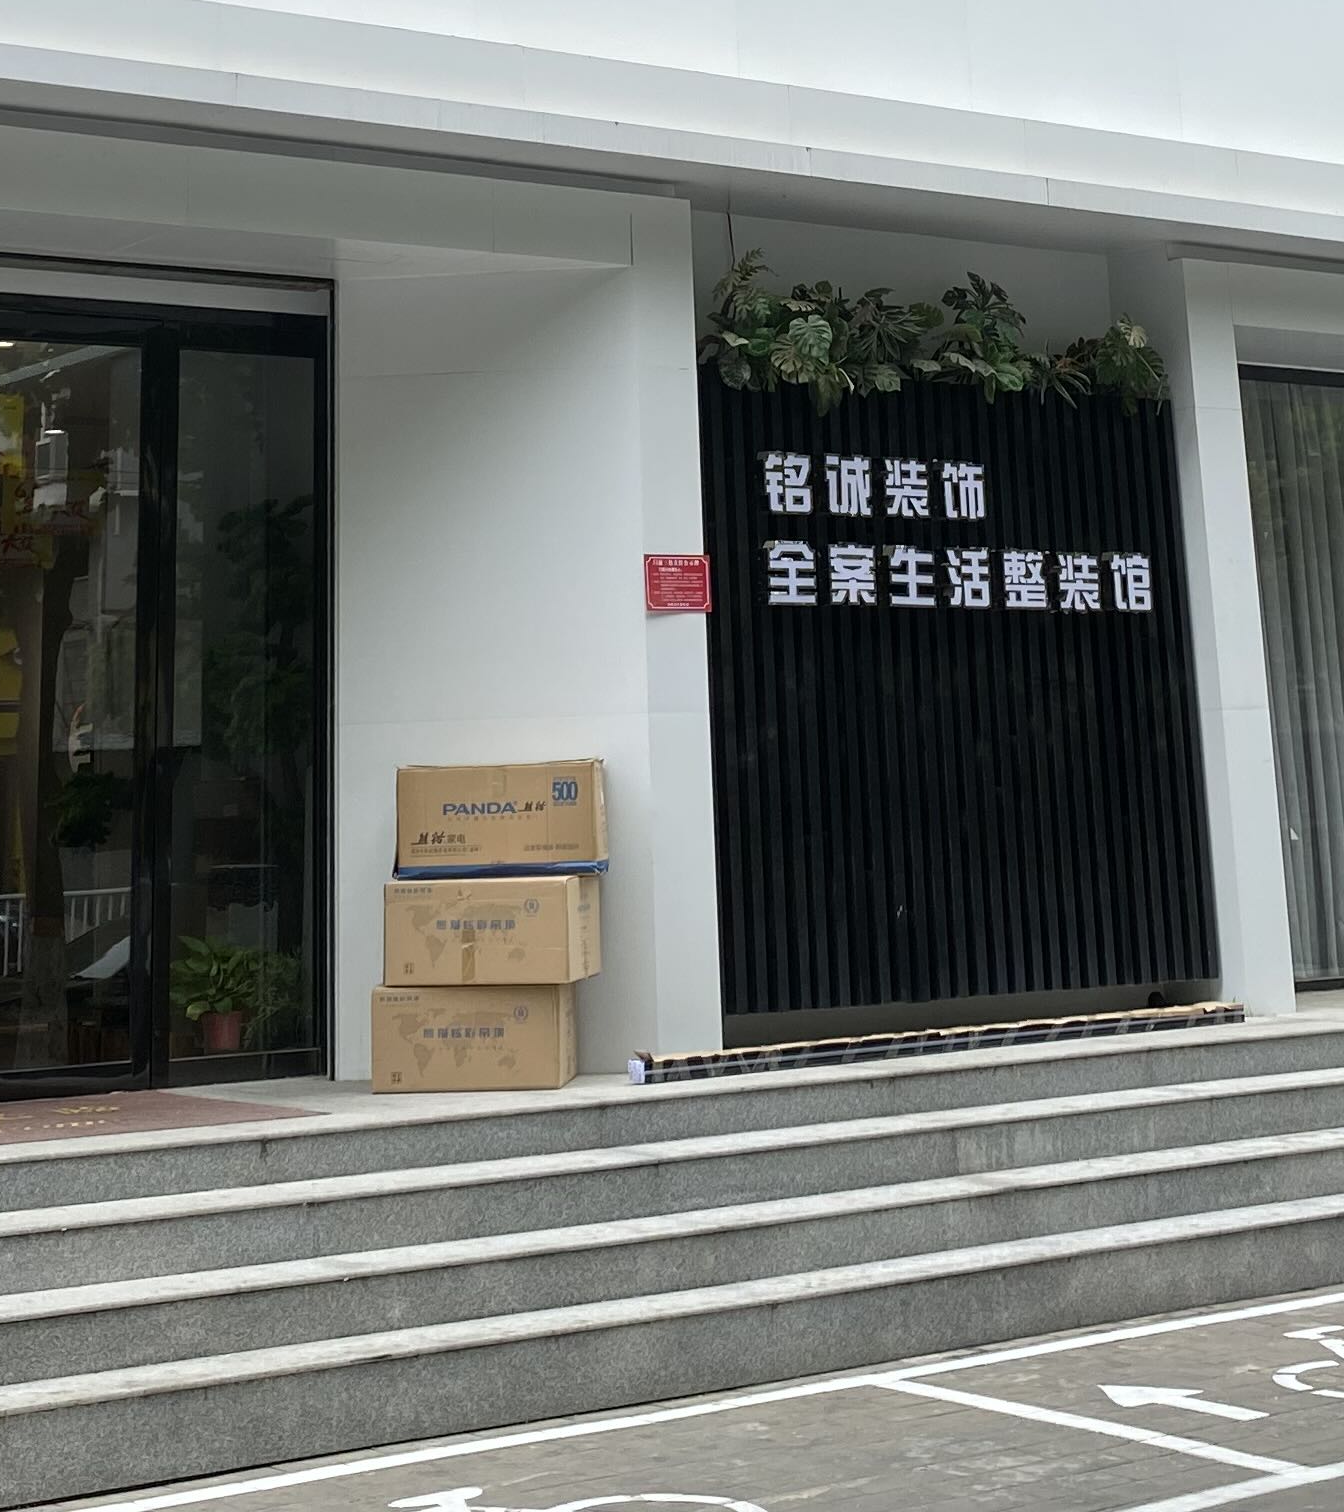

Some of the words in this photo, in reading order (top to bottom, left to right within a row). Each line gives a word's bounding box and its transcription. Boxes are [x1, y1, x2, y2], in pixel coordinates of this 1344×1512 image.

[764, 452, 985, 520] 铭诚装饰
[768, 540, 1152, 612] 全案生活整装馆
[442, 802, 517, 816] PANDA
